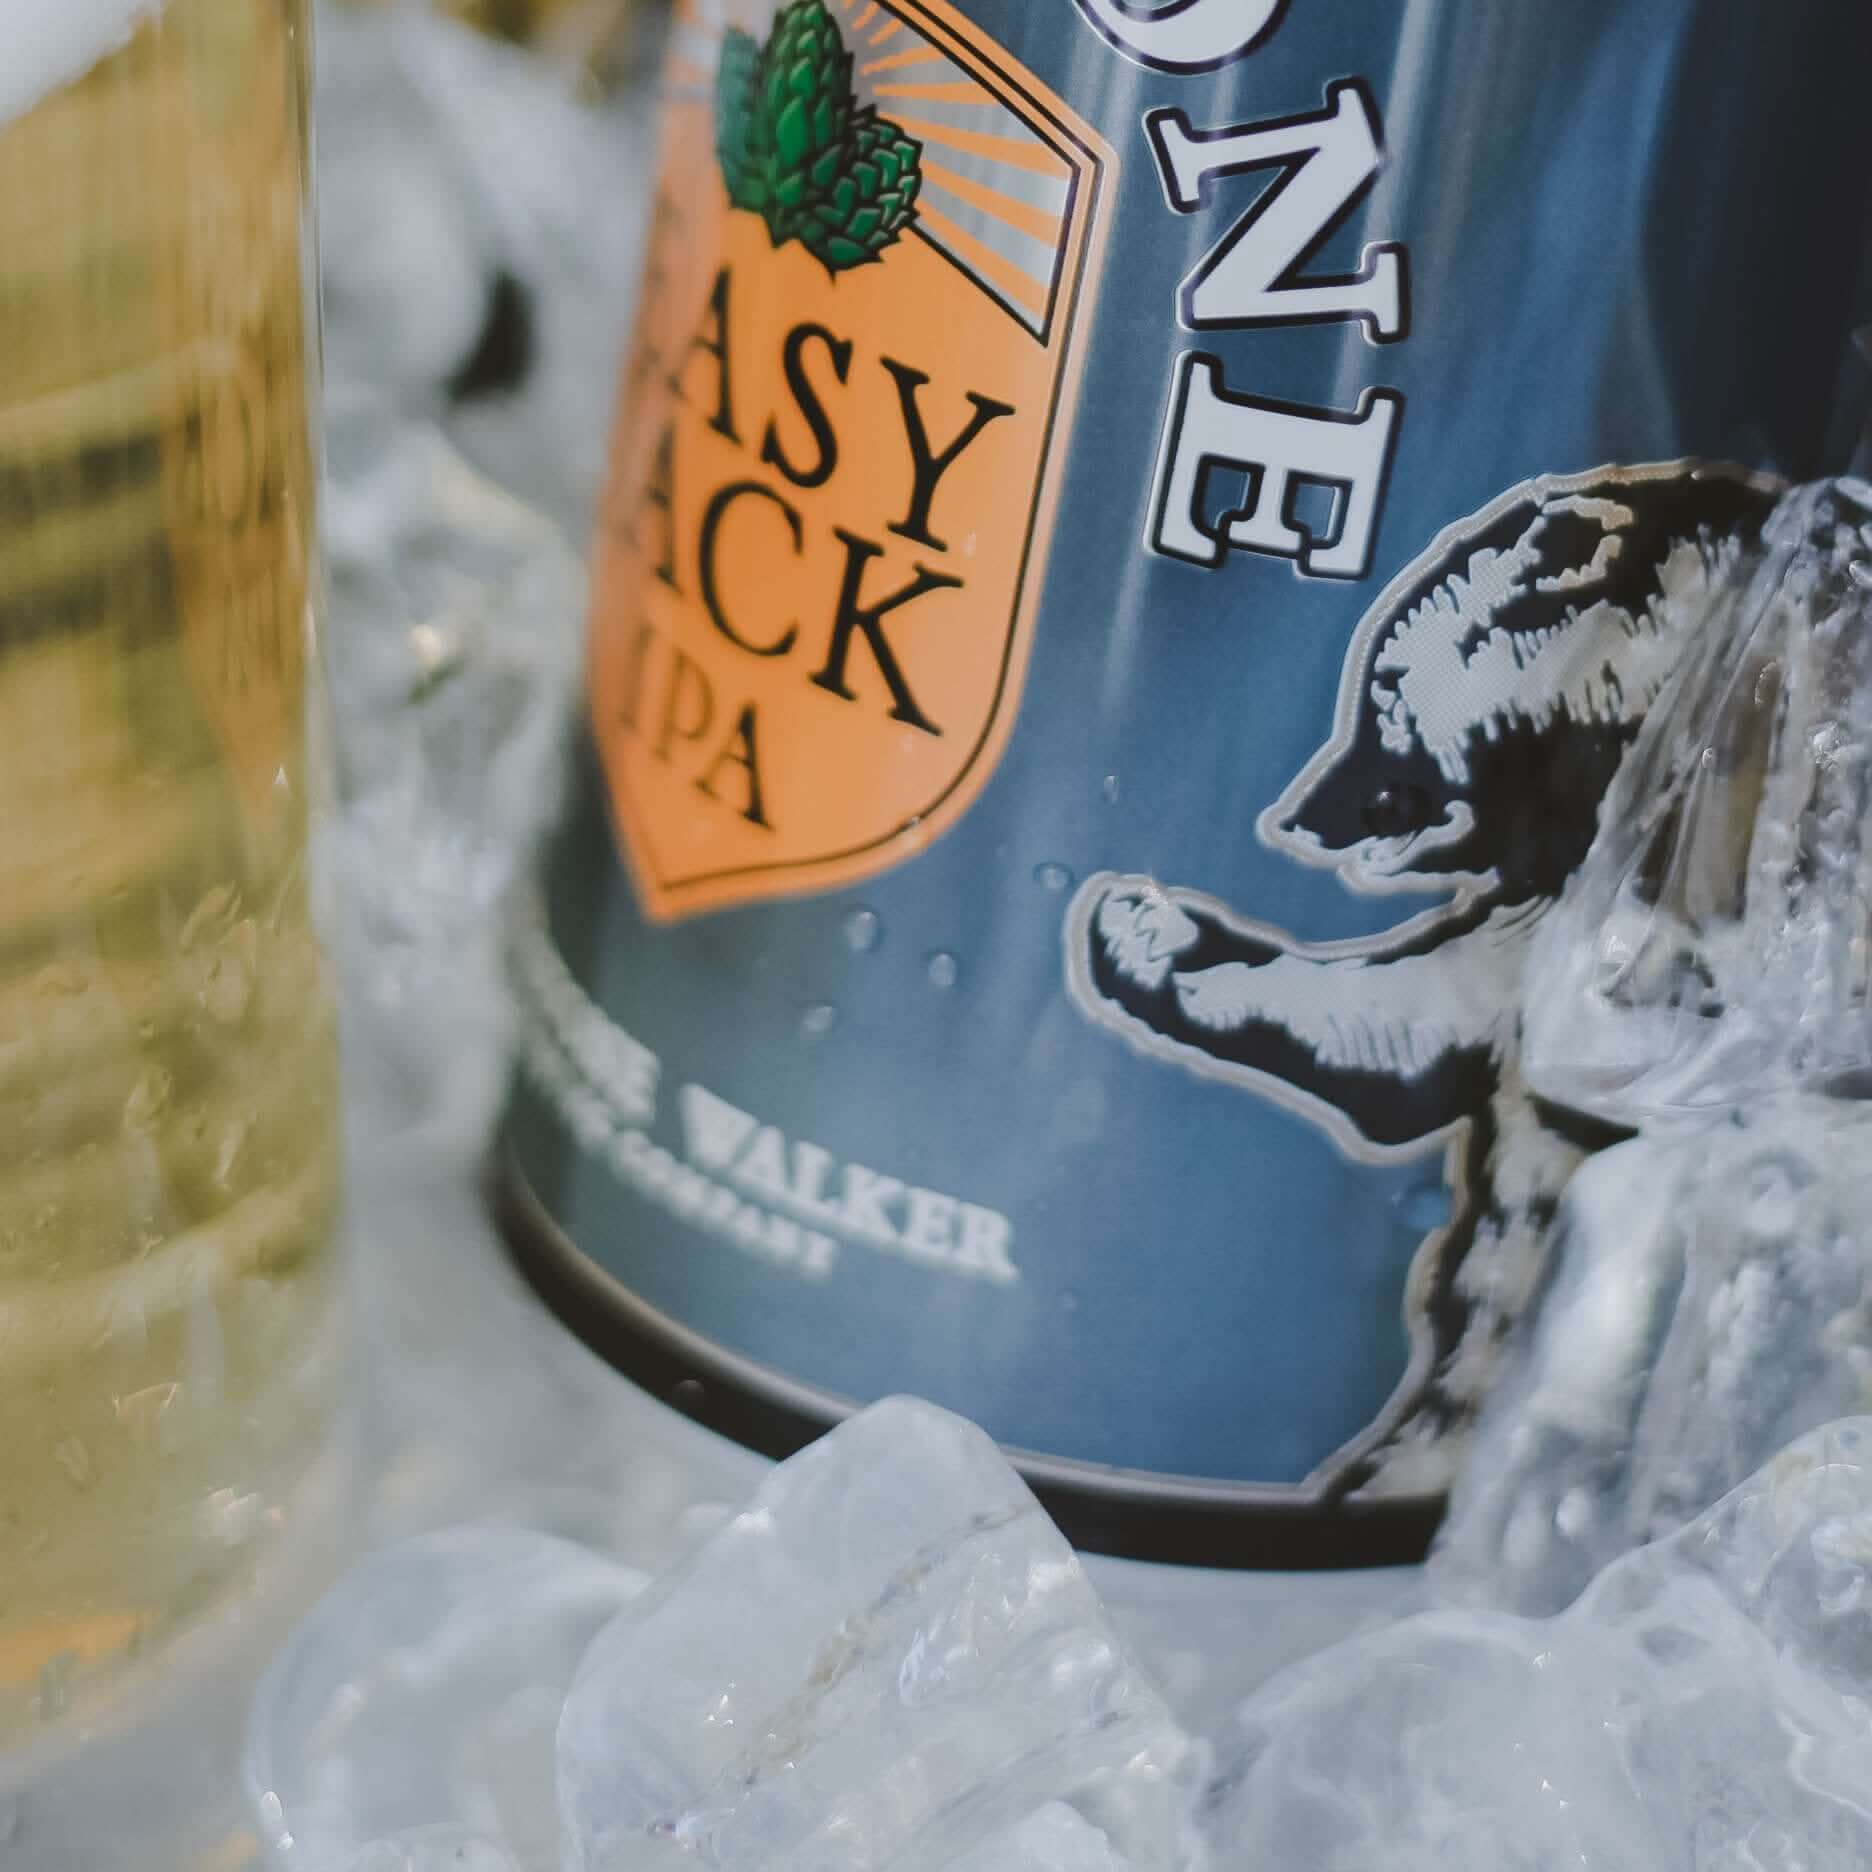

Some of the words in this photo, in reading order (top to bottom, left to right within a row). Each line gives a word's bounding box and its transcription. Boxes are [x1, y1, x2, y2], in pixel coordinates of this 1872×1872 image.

[638, 260, 1016, 552] ASY
[623, 420, 964, 736] ACK
[679, 1081, 1021, 1286] WALKER
